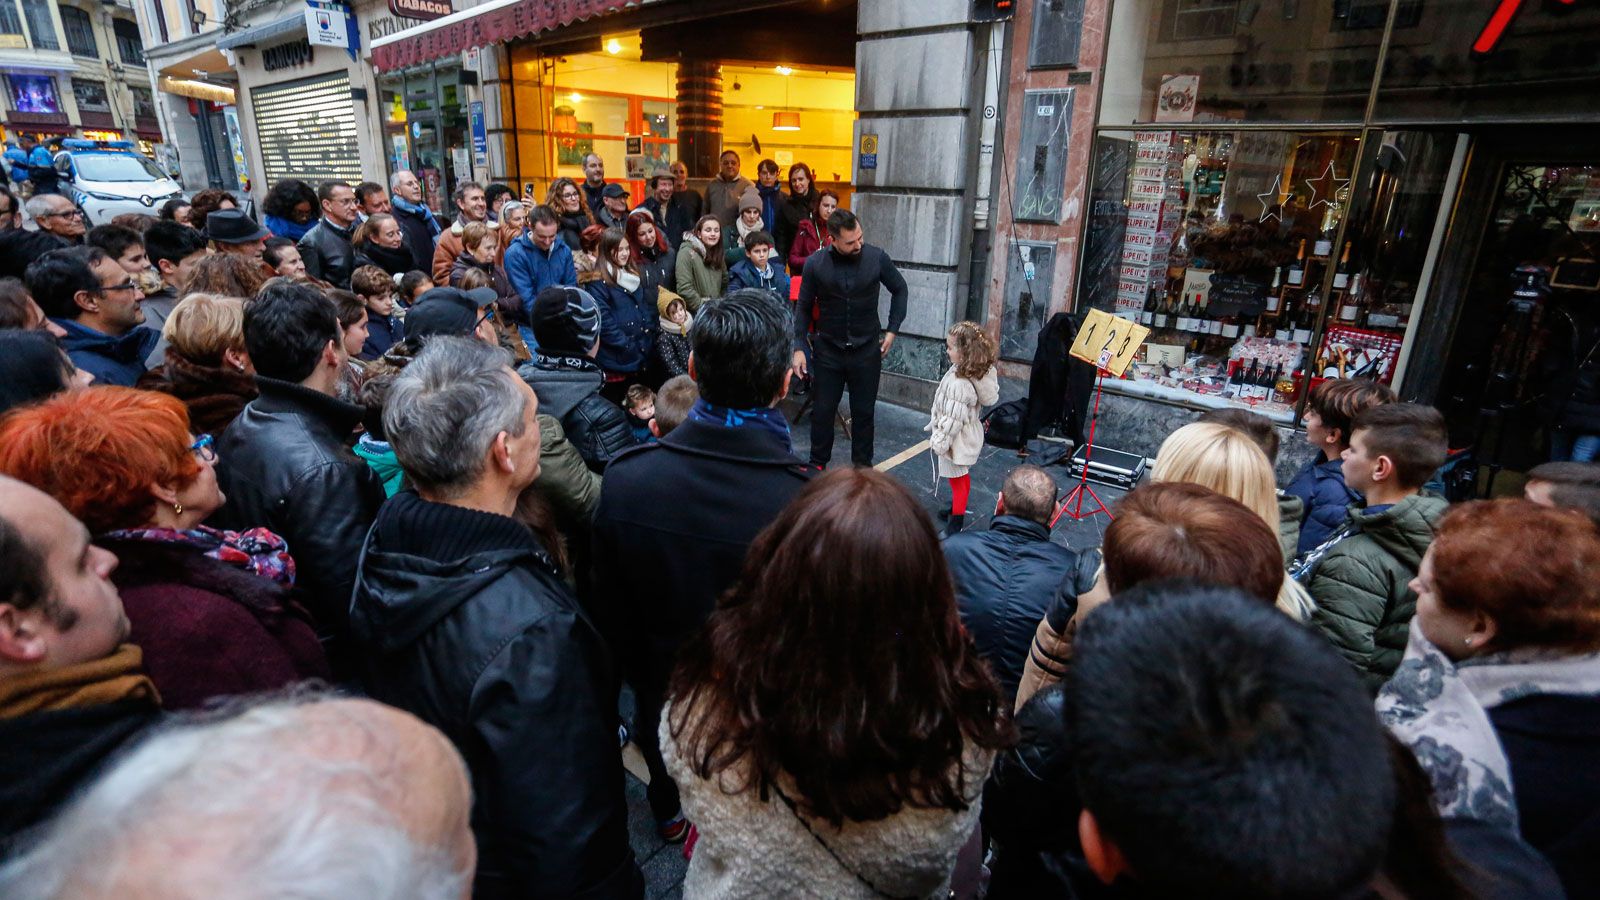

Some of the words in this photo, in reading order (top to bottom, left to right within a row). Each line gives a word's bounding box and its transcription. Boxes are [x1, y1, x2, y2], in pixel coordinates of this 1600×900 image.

[398, 0, 451, 15] TABACOS
[1135, 133, 1154, 141] FELIPE
[1136, 149, 1150, 159] LIPE
[1084, 323, 1097, 346] 1
[1101, 329, 1116, 351] 2
[1116, 336, 1131, 358] 3
